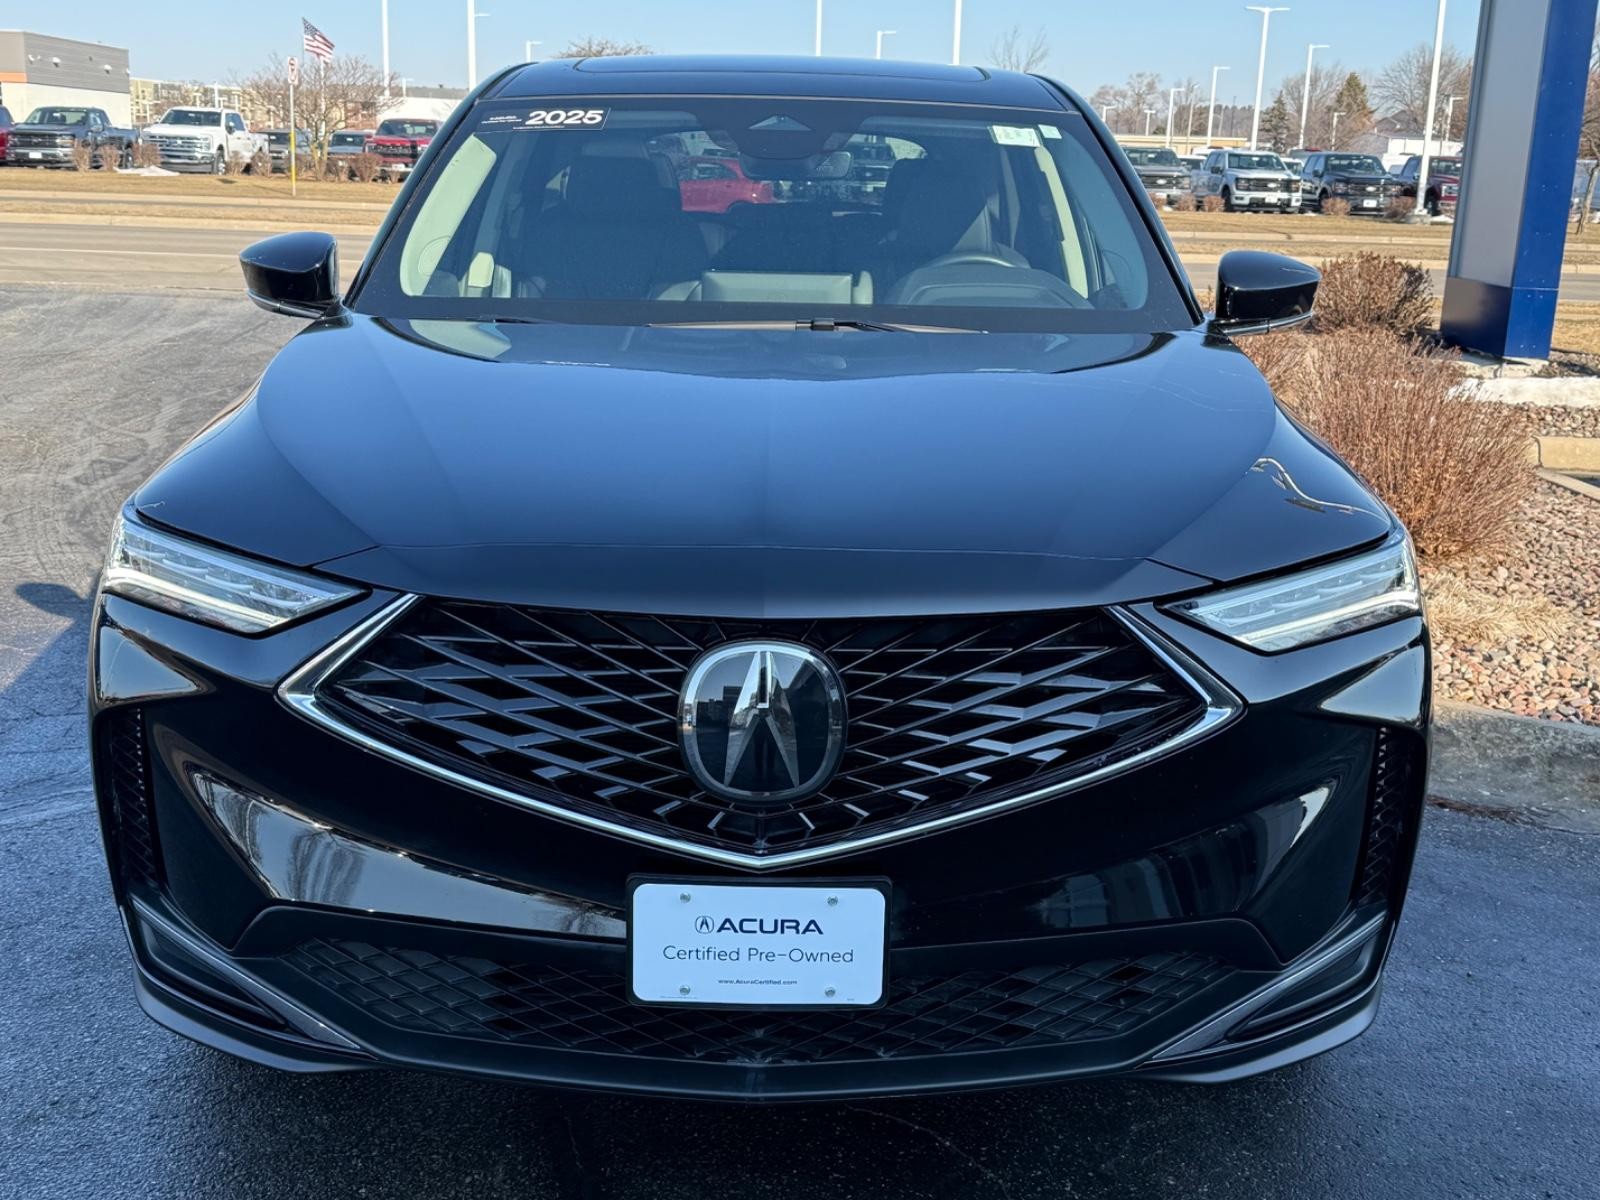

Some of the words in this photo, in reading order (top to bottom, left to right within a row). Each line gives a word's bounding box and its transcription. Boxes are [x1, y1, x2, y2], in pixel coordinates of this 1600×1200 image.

[525, 110, 604, 125] 2025
[716, 918, 824, 935] ACURA
[662, 945, 740, 961] Certified
[747, 948, 854, 963] Pre-Owned
[717, 978, 798, 986] www.AcuraCertified.com
